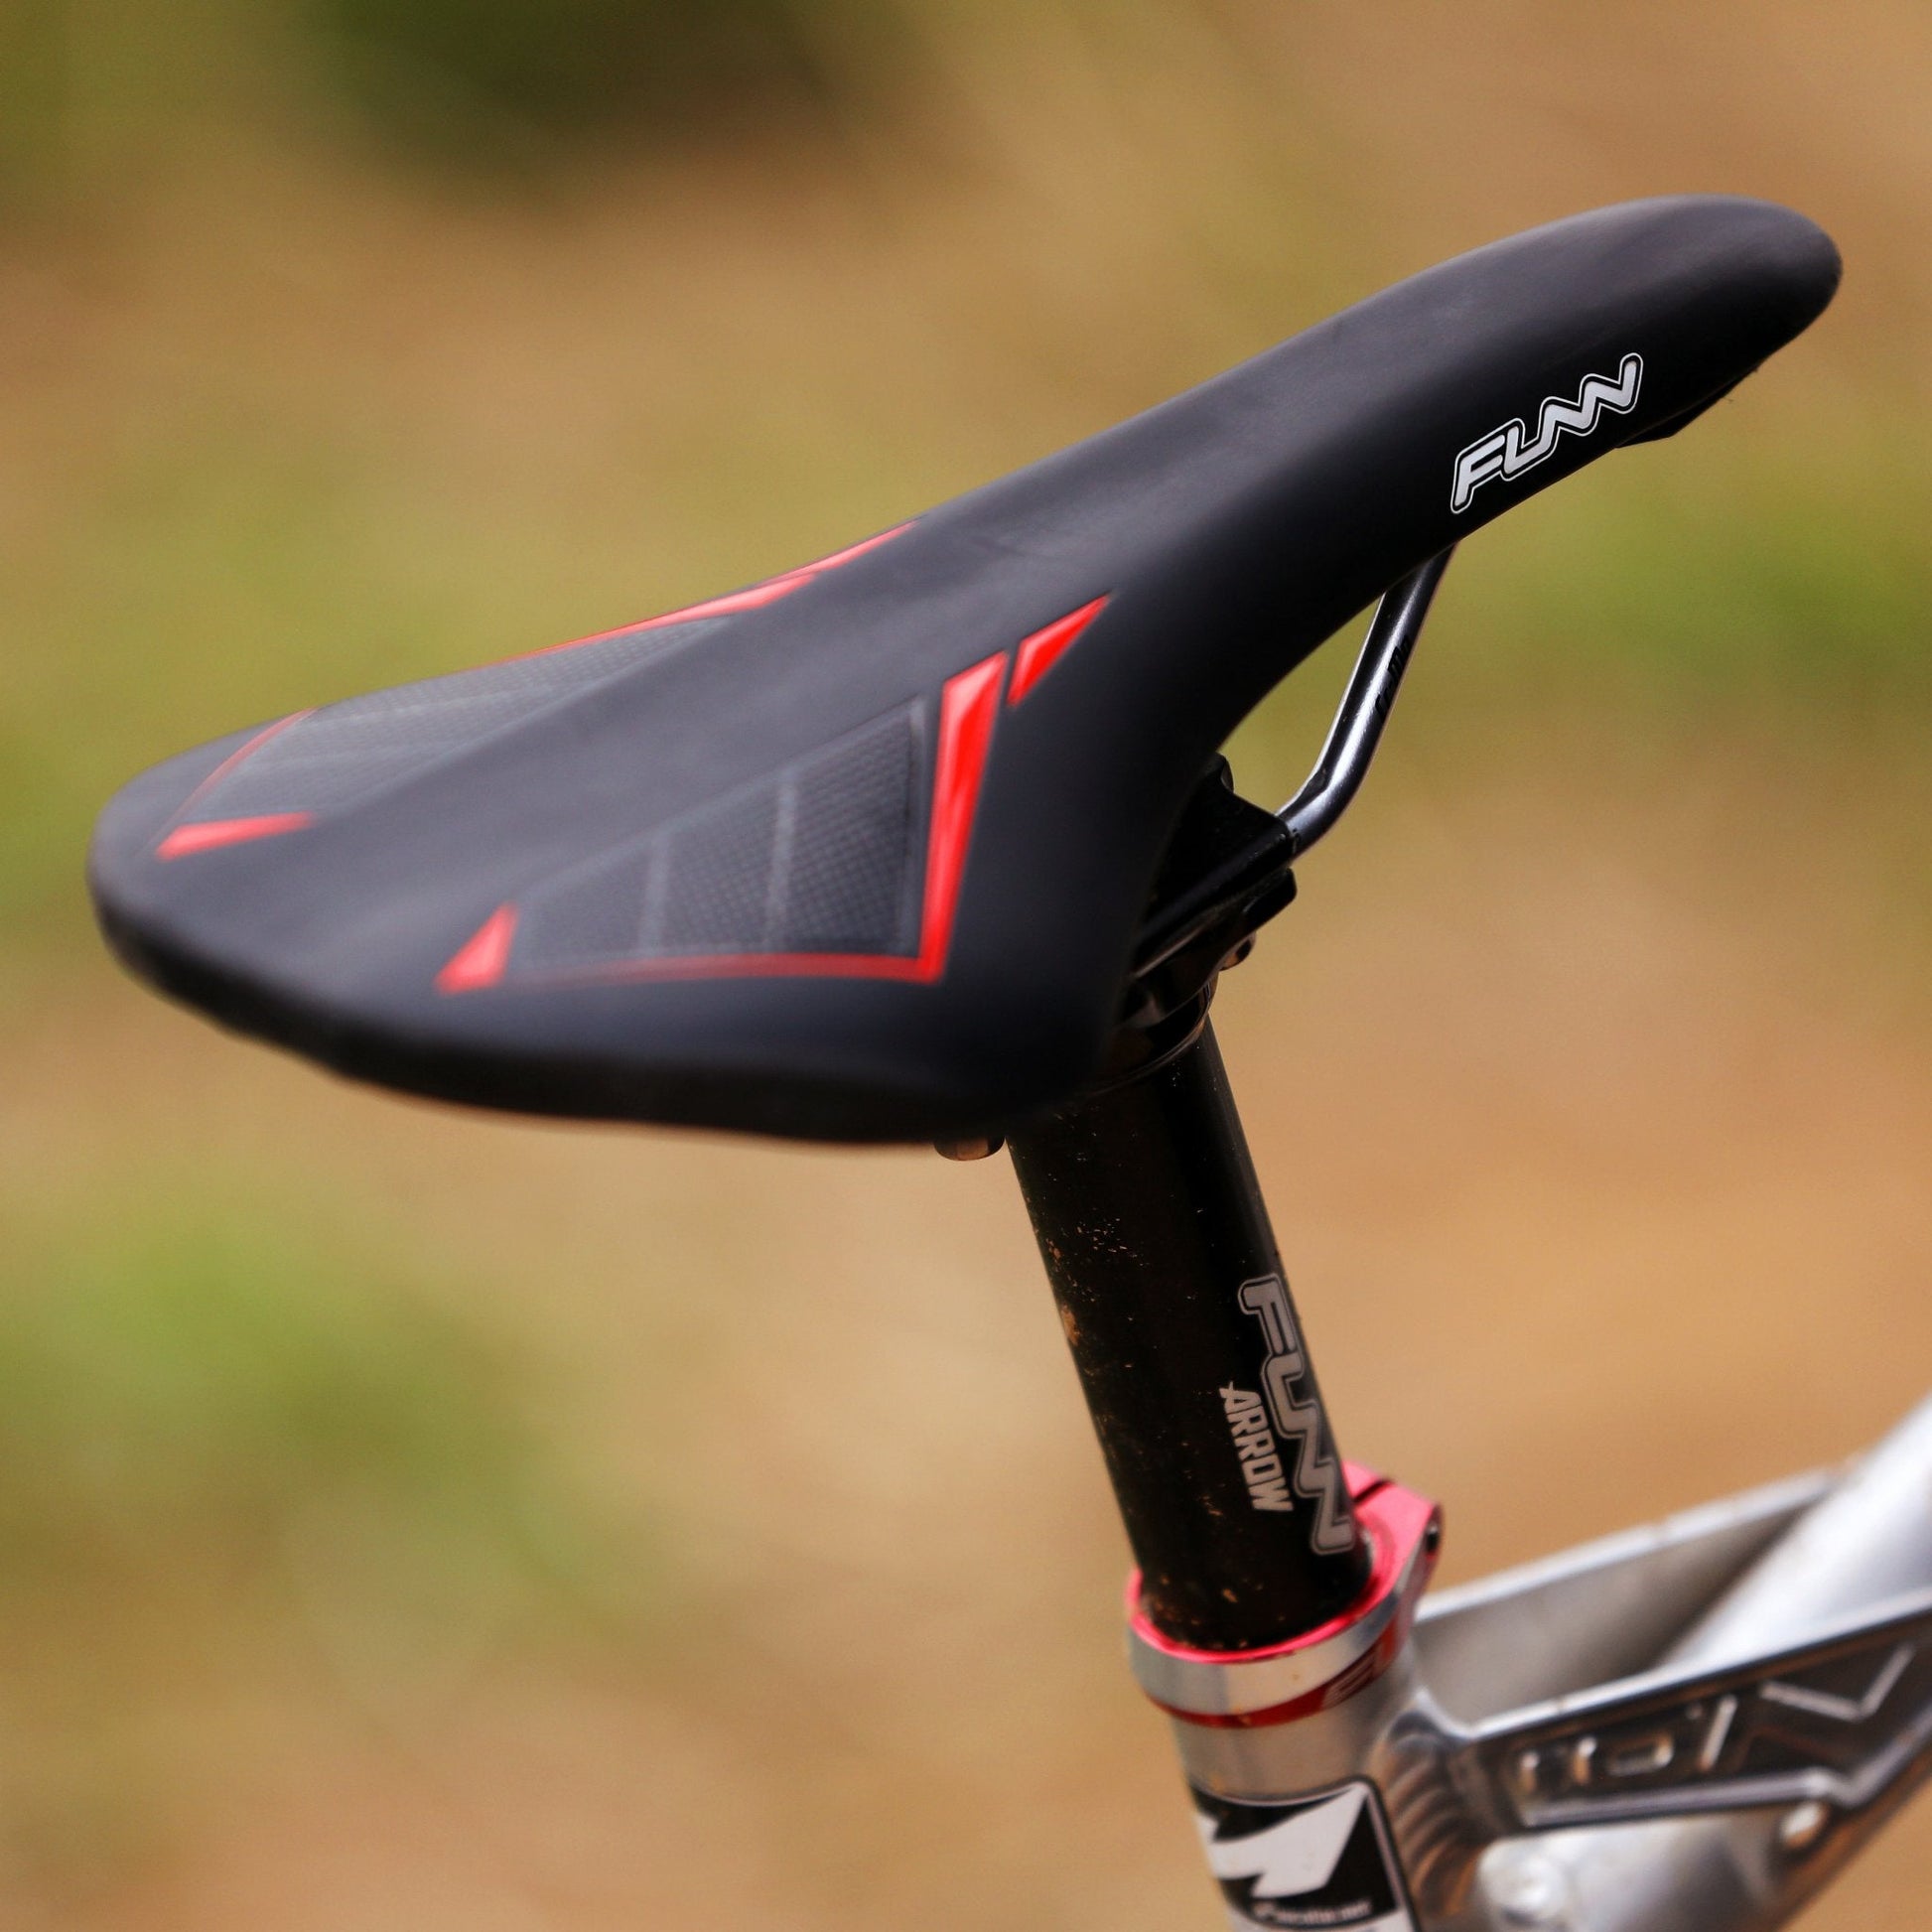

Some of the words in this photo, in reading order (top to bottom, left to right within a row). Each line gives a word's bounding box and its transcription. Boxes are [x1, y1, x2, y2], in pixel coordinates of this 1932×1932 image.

[1451, 353, 1643, 514] FUNN
[1219, 1381, 1295, 1512] ARROW
[1238, 1274, 1356, 1556] FUNN
